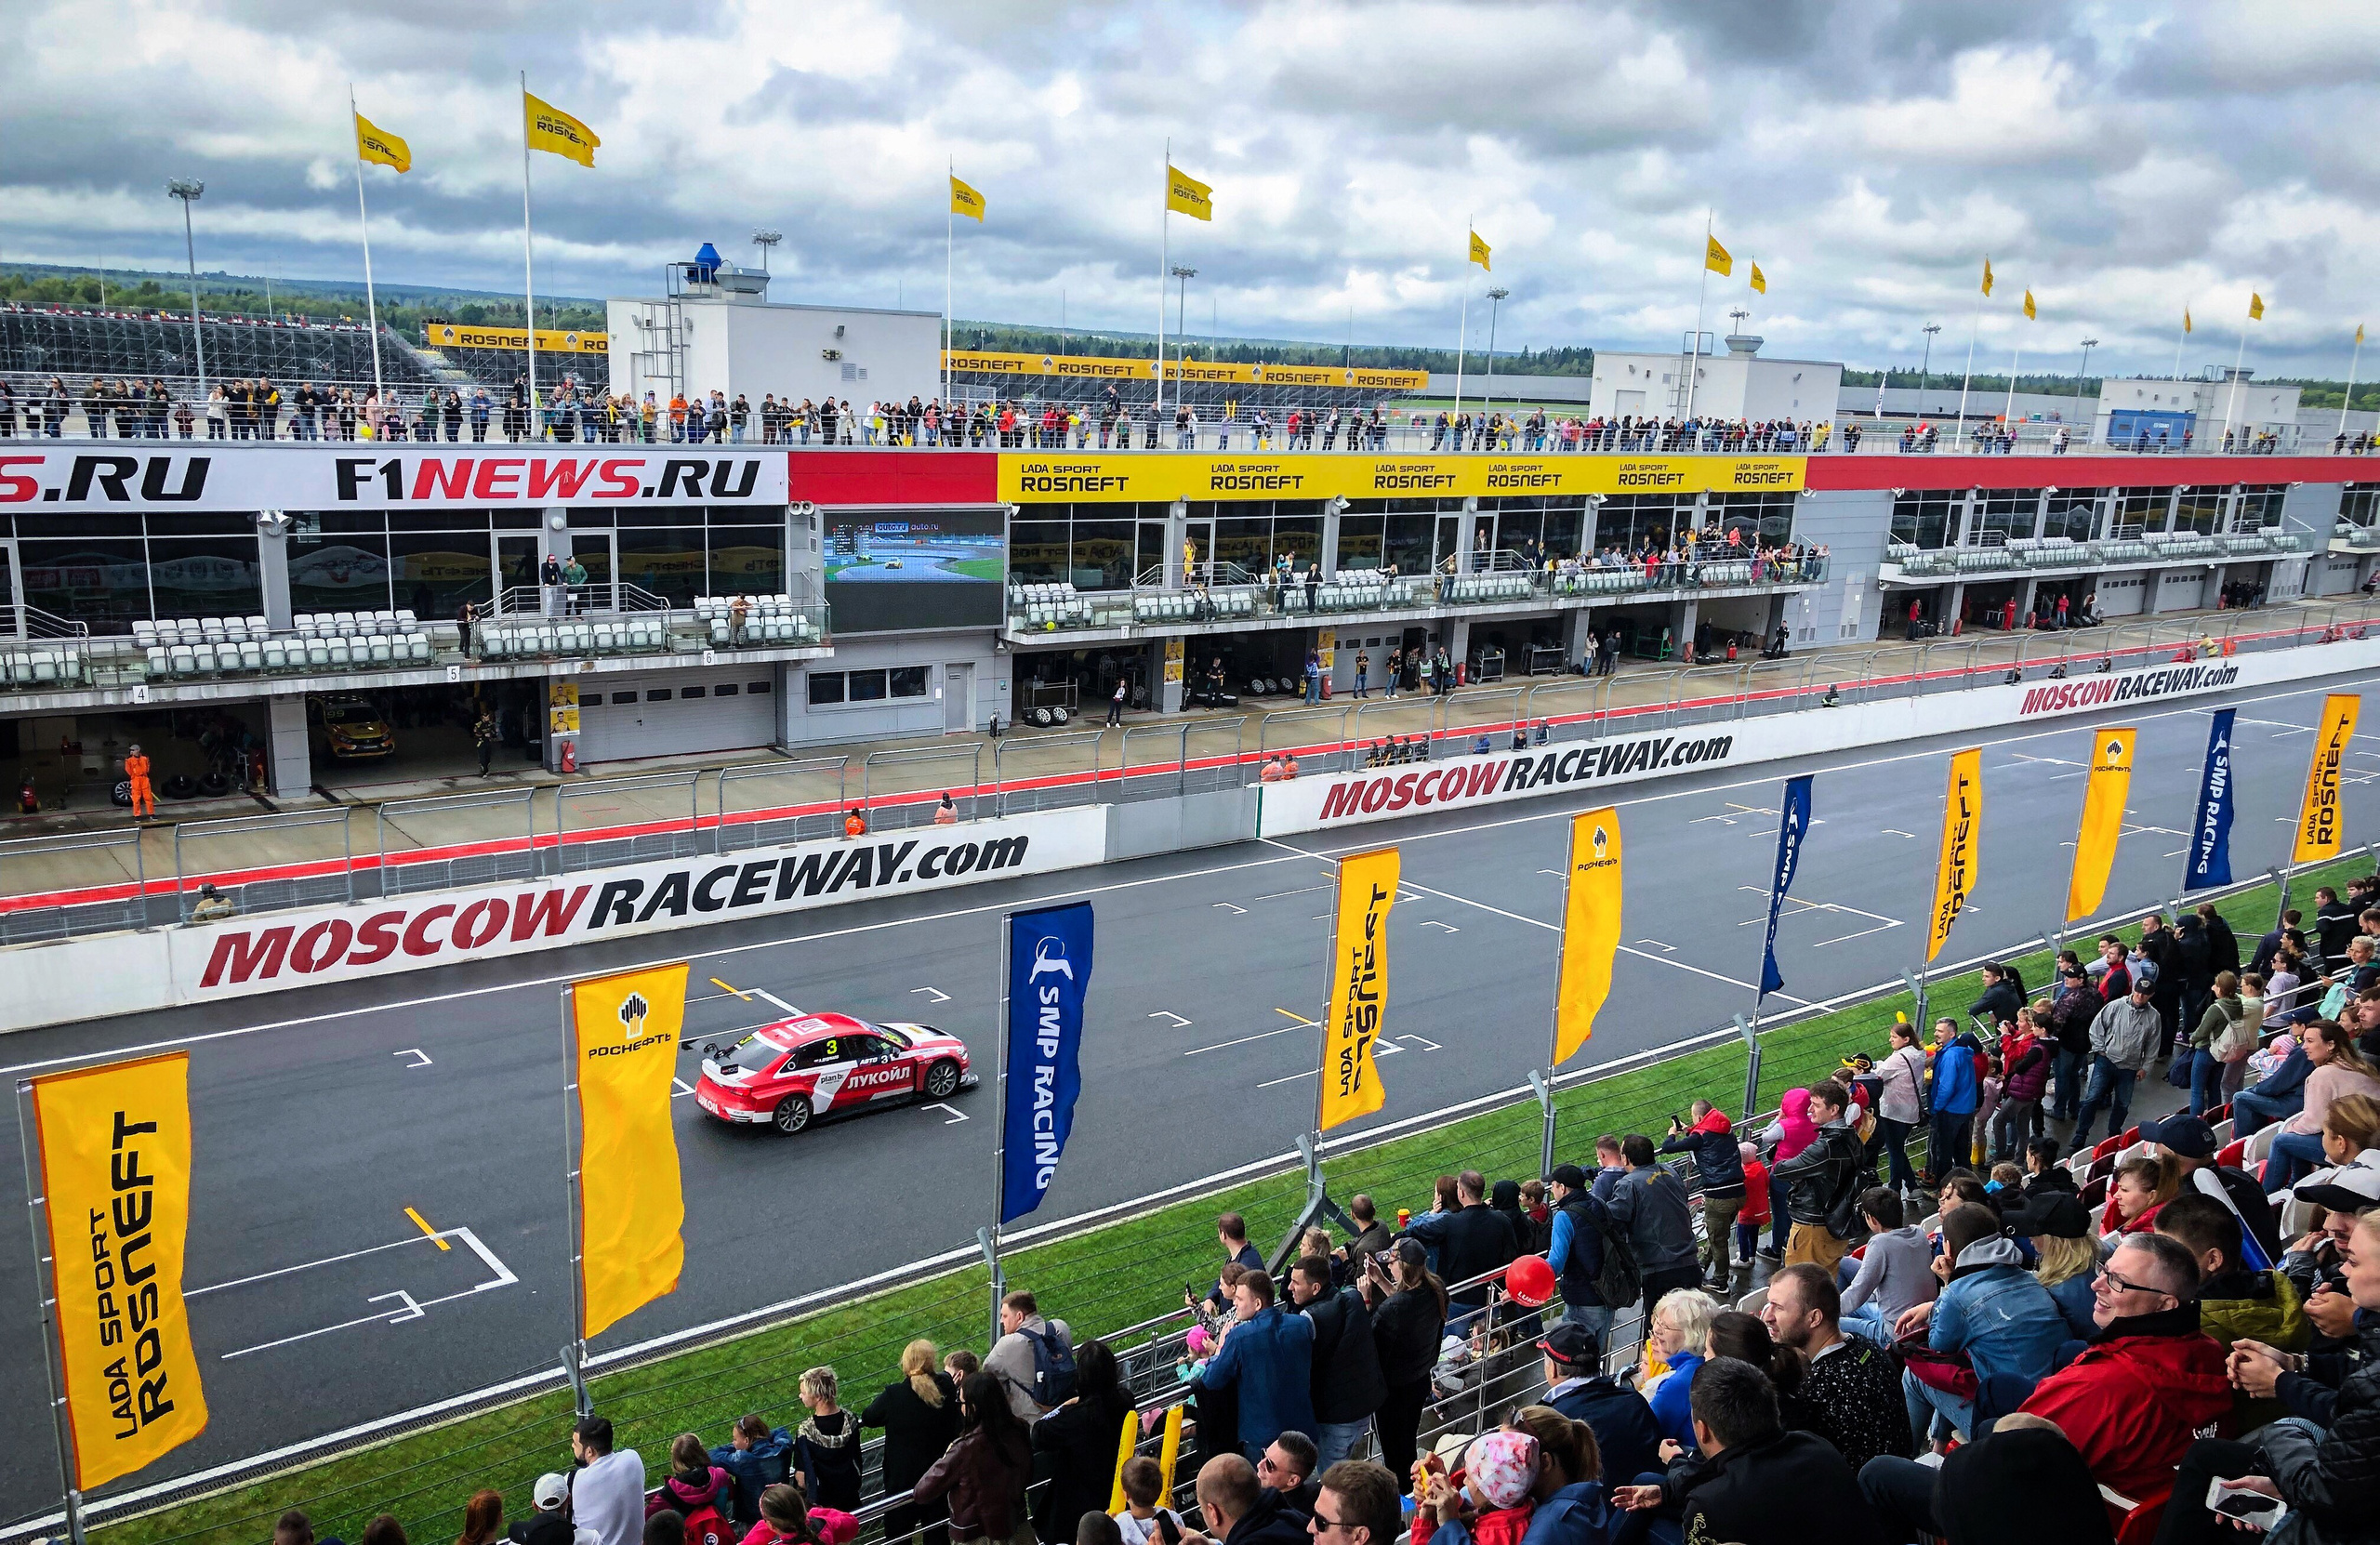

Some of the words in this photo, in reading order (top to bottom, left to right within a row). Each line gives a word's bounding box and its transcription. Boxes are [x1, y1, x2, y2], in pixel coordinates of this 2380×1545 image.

[460, 334, 547, 348] ROSNEFT
[945, 358, 1025, 370] ROSNEFT
[1058, 363, 1134, 376] ROSNEFT
[1166, 367, 1236, 379] ROSNEFT
[1265, 372, 1330, 384] ROSNEFT
[1357, 376, 1419, 386] ROSNEFT
[1022, 464, 1048, 473] LADA
[1053, 465, 1101, 473] SPORT
[1211, 464, 1234, 472] LADA
[1376, 464, 1395, 472] LADA
[1488, 464, 1507, 472] LADA
[1620, 463, 1636, 471] LADA
[336, 458, 760, 500] F1NEWS.RU
[1021, 476, 1129, 492] ROSNEFT
[1210, 475, 1303, 490] ROSNEFT
[1374, 475, 1456, 489] ROSNEFT
[1488, 474, 1562, 487] ROSNEFT
[1619, 473, 1685, 485] ROSNEFT
[1734, 472, 1793, 484] ROSNEFT
[1123, 627, 1128, 638] 7
[706, 651, 712, 665] 6
[450, 667, 457, 680] 5
[138, 686, 145, 701] 4
[2209, 755, 2228, 799] SMP
[2312, 751, 2326, 808] SPORT
[2307, 812, 2318, 845] LADA
[2197, 801, 2220, 874] RACING
[1780, 835, 1795, 887] SMP
[1937, 900, 1950, 940] LADA
[1342, 946, 1362, 1039] SPORT
[1037, 985, 1061, 1059] SMP
[588, 1033, 671, 1060] РОСНЕФТЬ
[826, 1039, 838, 1055] 3
[820, 1075, 837, 1084] plan
[848, 1066, 911, 1089] ЛУКОЙЛ
[1339, 1046, 1353, 1098] LADA
[1033, 1065, 1059, 1191] RACING
[112, 1111, 175, 1428] ROSNEFT
[89, 1208, 124, 1348] SPORT
[104, 1356, 139, 1441] LADA
